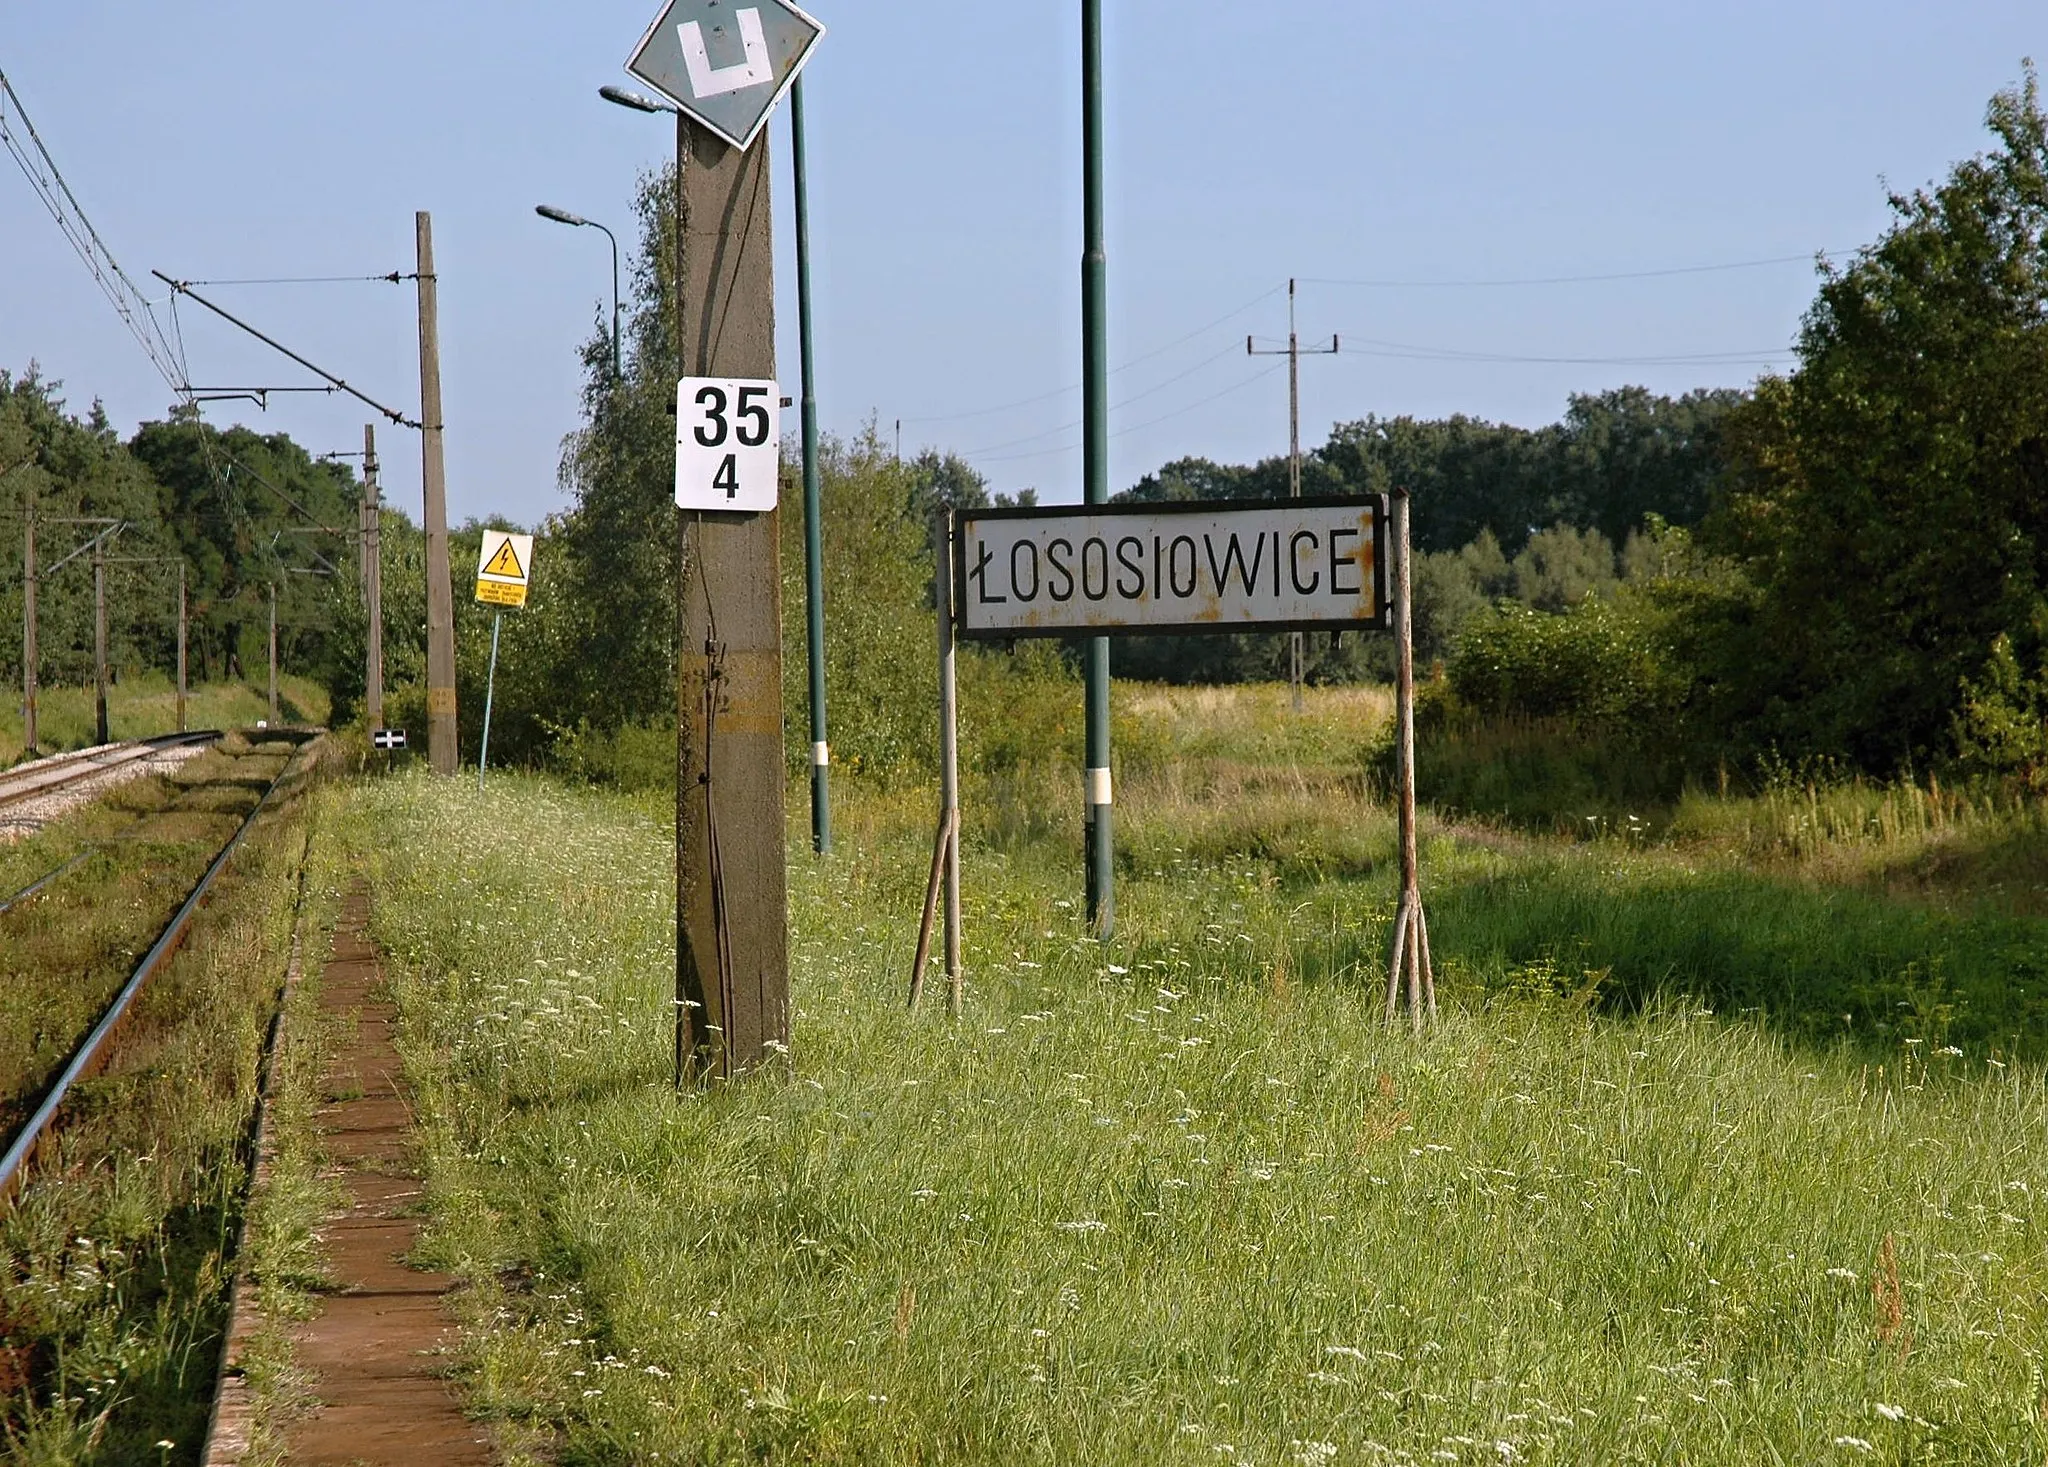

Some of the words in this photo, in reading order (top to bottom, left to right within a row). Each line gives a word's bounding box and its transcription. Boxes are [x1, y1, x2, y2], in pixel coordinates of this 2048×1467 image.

[693, 386, 770, 447] 35
[712, 453, 739, 498] 4
[969, 528, 1361, 604] ŁOSOSIOWICE
